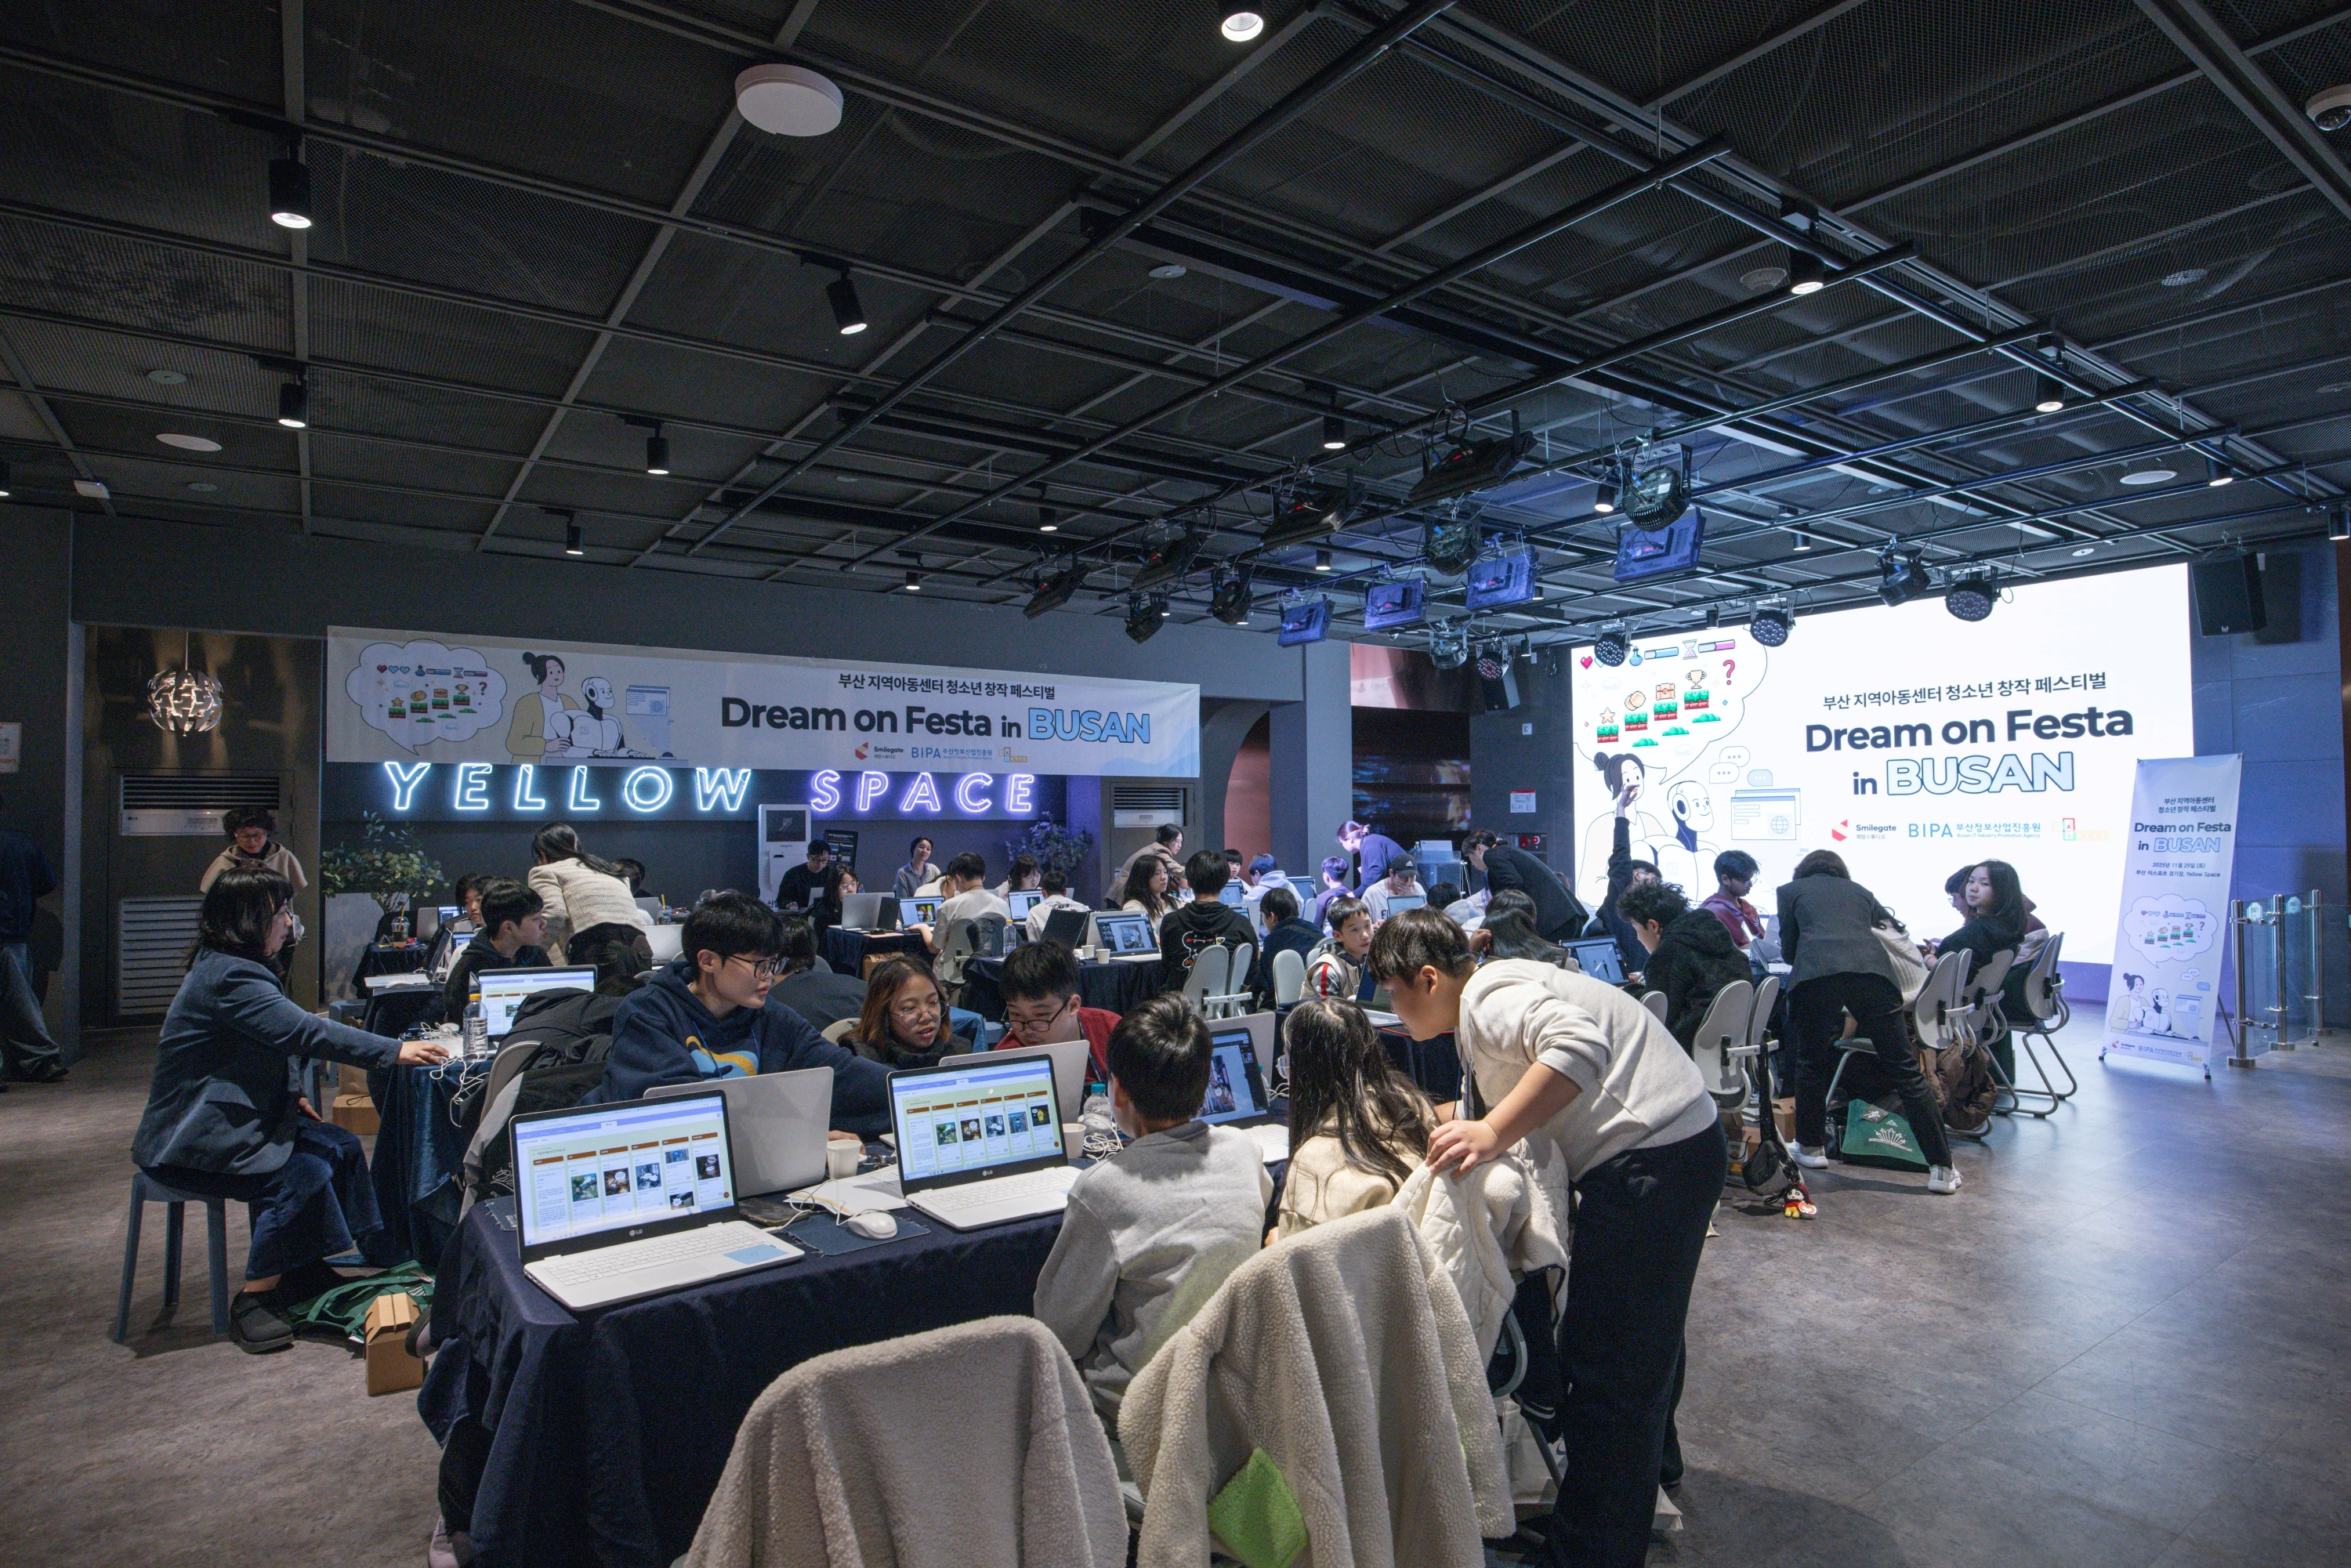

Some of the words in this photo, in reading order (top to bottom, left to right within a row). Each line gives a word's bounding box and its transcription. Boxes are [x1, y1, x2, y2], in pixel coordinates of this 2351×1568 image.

[839, 674, 865, 690] 부산
[868, 675, 944, 693] 지역아동센터
[947, 680, 982, 696] 청소년
[984, 683, 1009, 697] 창작
[1010, 683, 1056, 700] 페스티벌
[1823, 695, 1850, 711] 부산
[1853, 686, 1942, 708] 지역아동센터
[1945, 682, 1994, 701] 청소년
[1998, 679, 2031, 697] 창작
[2034, 672, 2107, 693] 페스티벌
[722, 697, 846, 730] Dream
[853, 709, 897, 733] on
[906, 705, 992, 737] Festa
[1002, 715, 1021, 737] in
[1028, 708, 1150, 744] BUSAN
[1806, 722, 1933, 752] Dream
[1941, 719, 1995, 745] on
[2007, 707, 2133, 742] Festa
[911, 747, 941, 759] BIPA
[942, 748, 993, 756] 부산정보산업진흥원
[1853, 772, 1878, 795] in
[1886, 751, 2074, 796] BUSAN
[384, 762, 752, 812] YELLOW
[810, 769, 1034, 813] SPACE
[1856, 824, 1896, 833] Smilegate
[1908, 824, 1953, 838] BIPA
[1956, 823, 2041, 832] 부산정보산업진흥원
[2134, 823, 2176, 832] Dream
[2197, 822, 2231, 832] Festa
[2138, 841, 2149, 850] in
[2154, 837, 2221, 853] BUSAN
